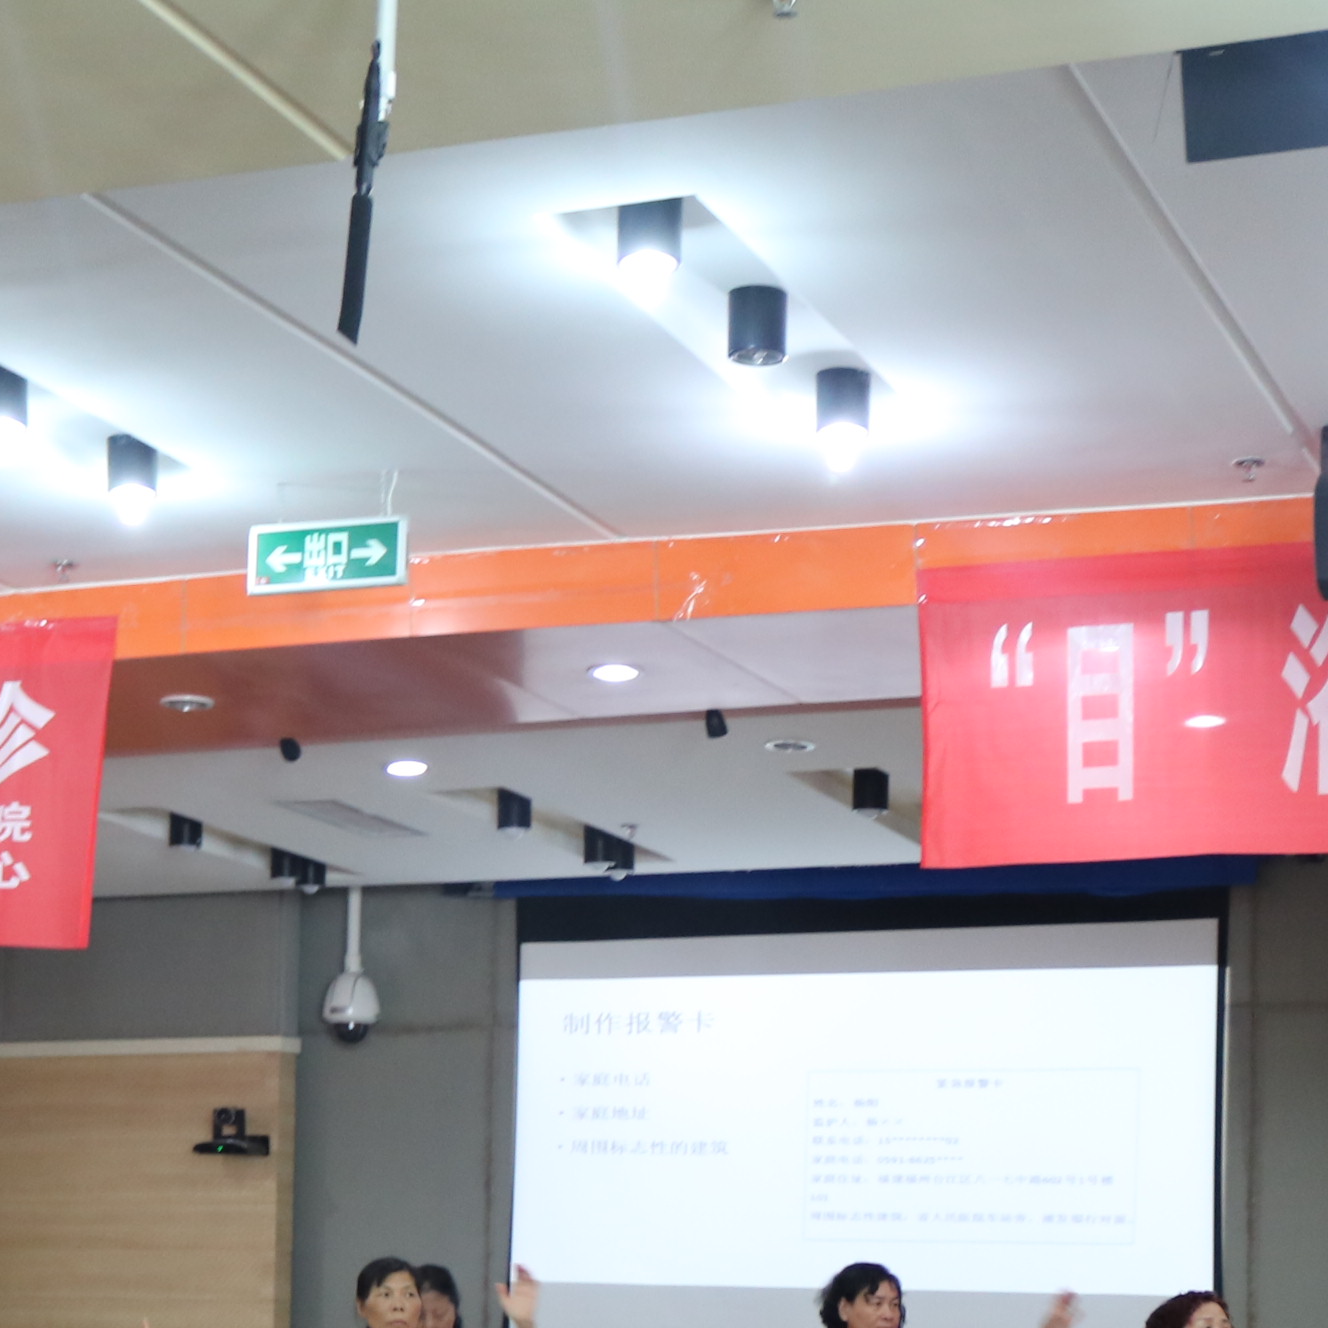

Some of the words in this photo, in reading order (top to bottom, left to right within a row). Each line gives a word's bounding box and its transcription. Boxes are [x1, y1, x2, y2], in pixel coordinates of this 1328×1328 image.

[303, 531, 349, 568] 出口
[304, 565, 345, 582] IT
[562, 1009, 716, 1035] 制作报警卡
